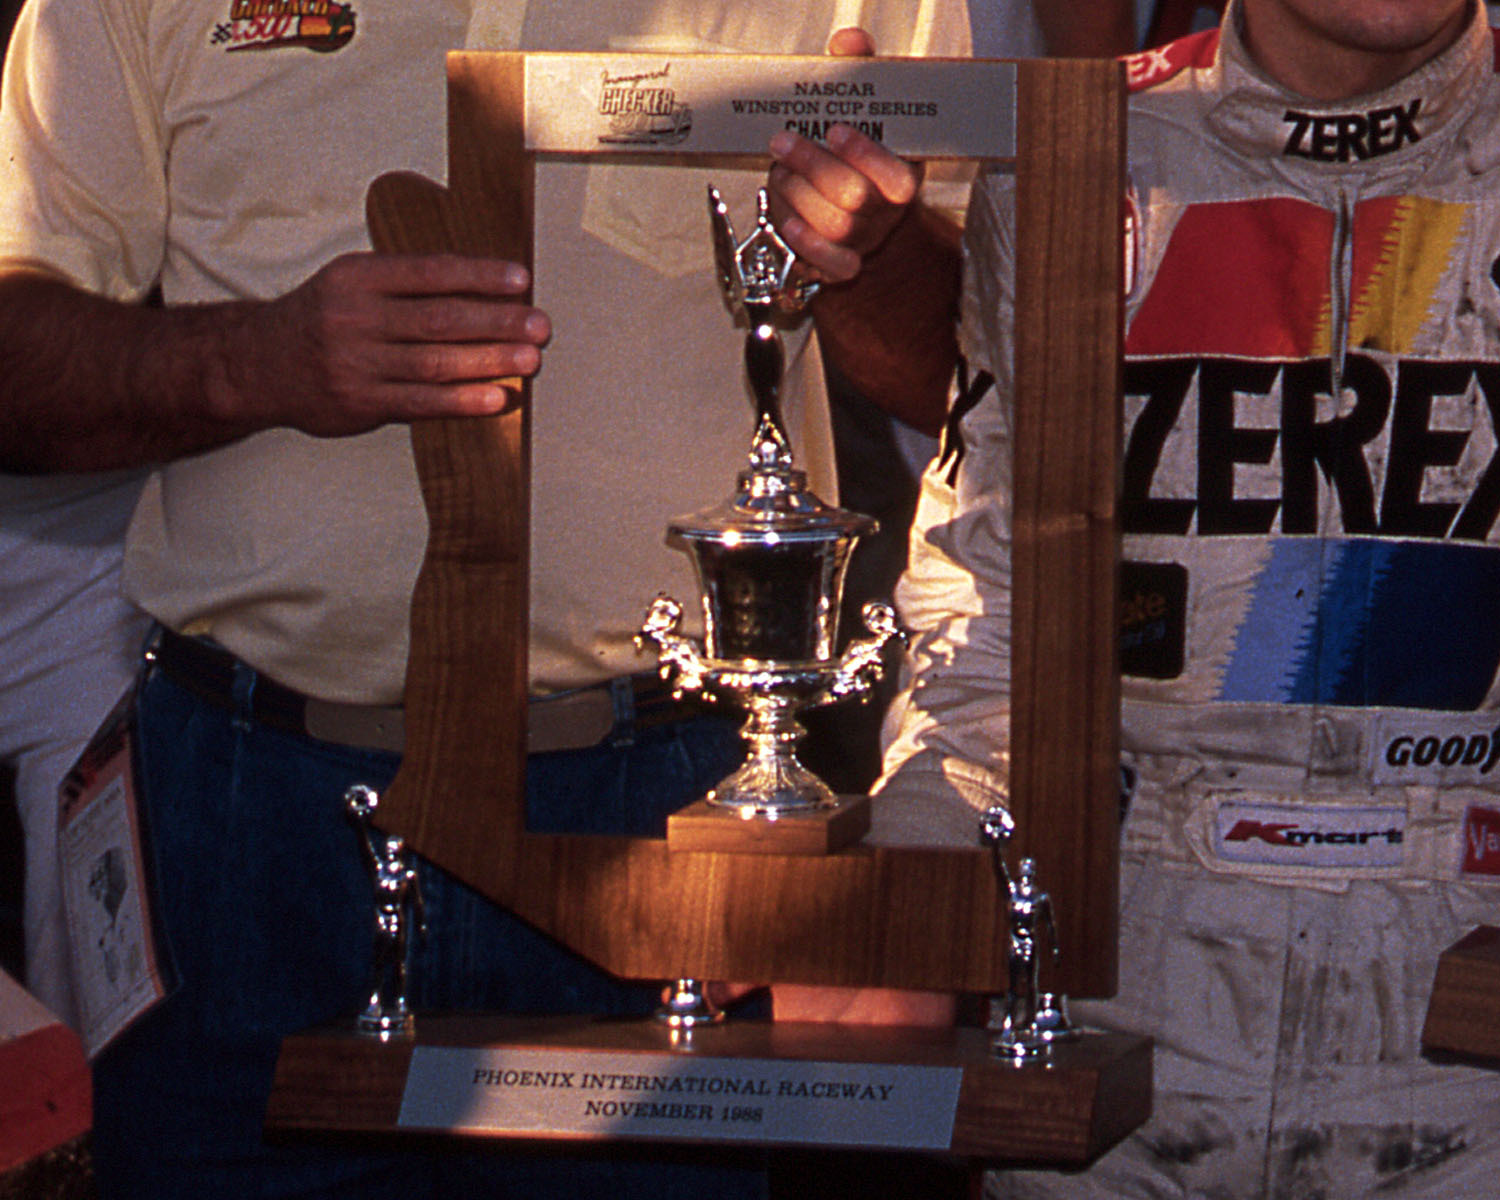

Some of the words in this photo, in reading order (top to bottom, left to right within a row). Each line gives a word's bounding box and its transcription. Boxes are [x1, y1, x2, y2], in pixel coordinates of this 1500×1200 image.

[598, 87, 676, 116] CHECKER
[794, 81, 876, 97] NASCAR
[731, 99, 821, 116] WINSTON
[825, 100, 865, 116] CUP
[868, 101, 939, 117] SERIES
[1281, 98, 1423, 162] ZEREX
[1224, 819, 1404, 848] Kmart
[471, 1068, 575, 1090] PHOENIX
[580, 1071, 772, 1098] INTERNATIONAL
[777, 1080, 895, 1102] RACEWAY
[583, 1099, 714, 1122] NOVEMBER
[720, 1105, 764, 1123] 1988
